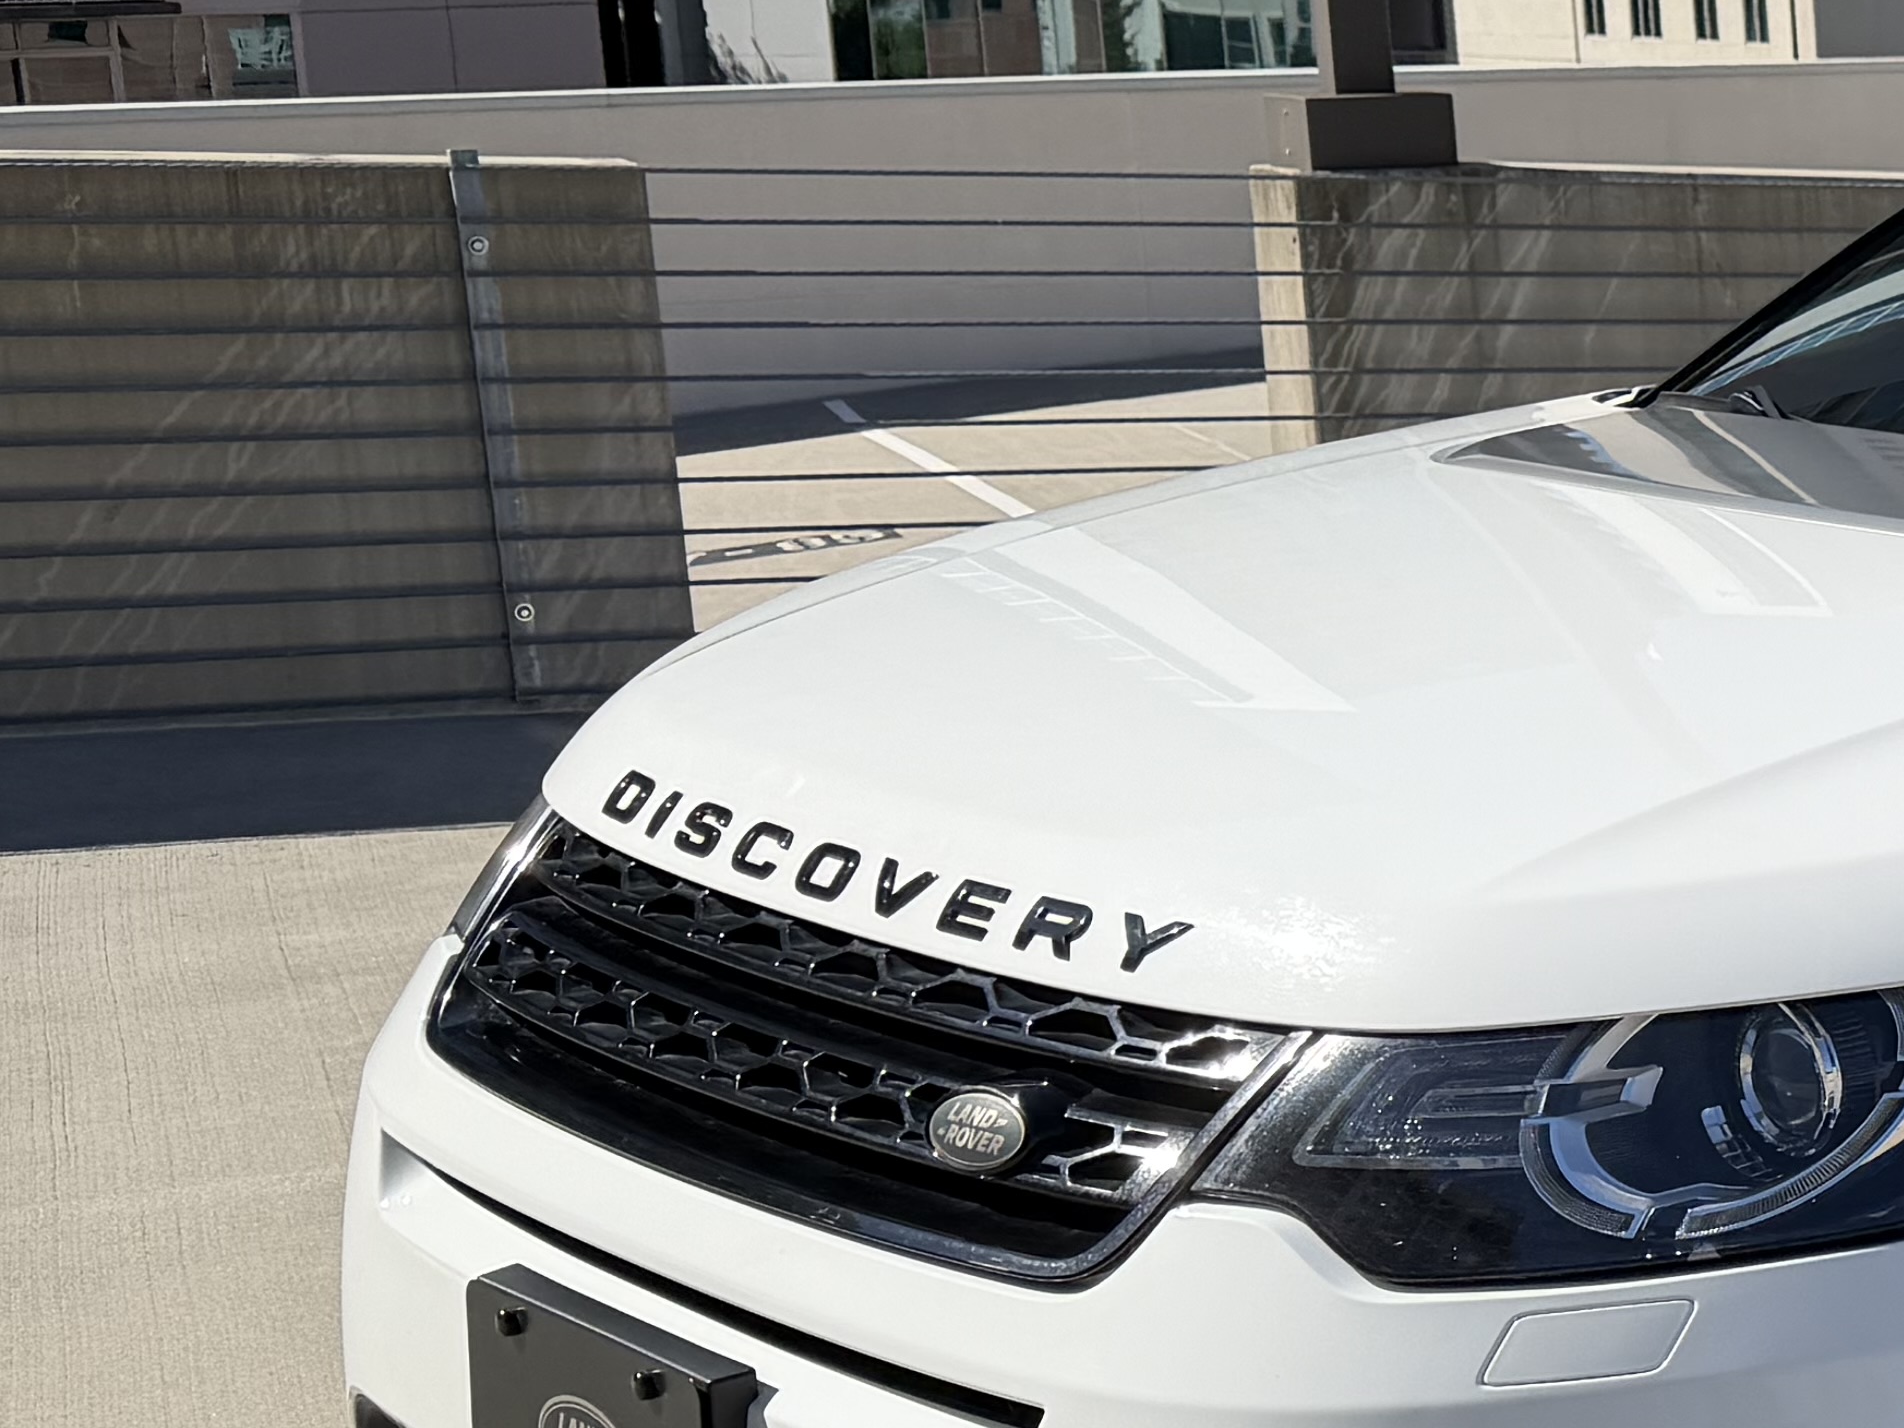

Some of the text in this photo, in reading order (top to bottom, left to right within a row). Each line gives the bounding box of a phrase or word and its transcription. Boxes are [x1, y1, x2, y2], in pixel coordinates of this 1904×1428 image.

[602, 770, 1193, 973] DISCOVERY
[947, 1101, 998, 1128] LAND
[943, 1123, 1005, 1156] ROVER
